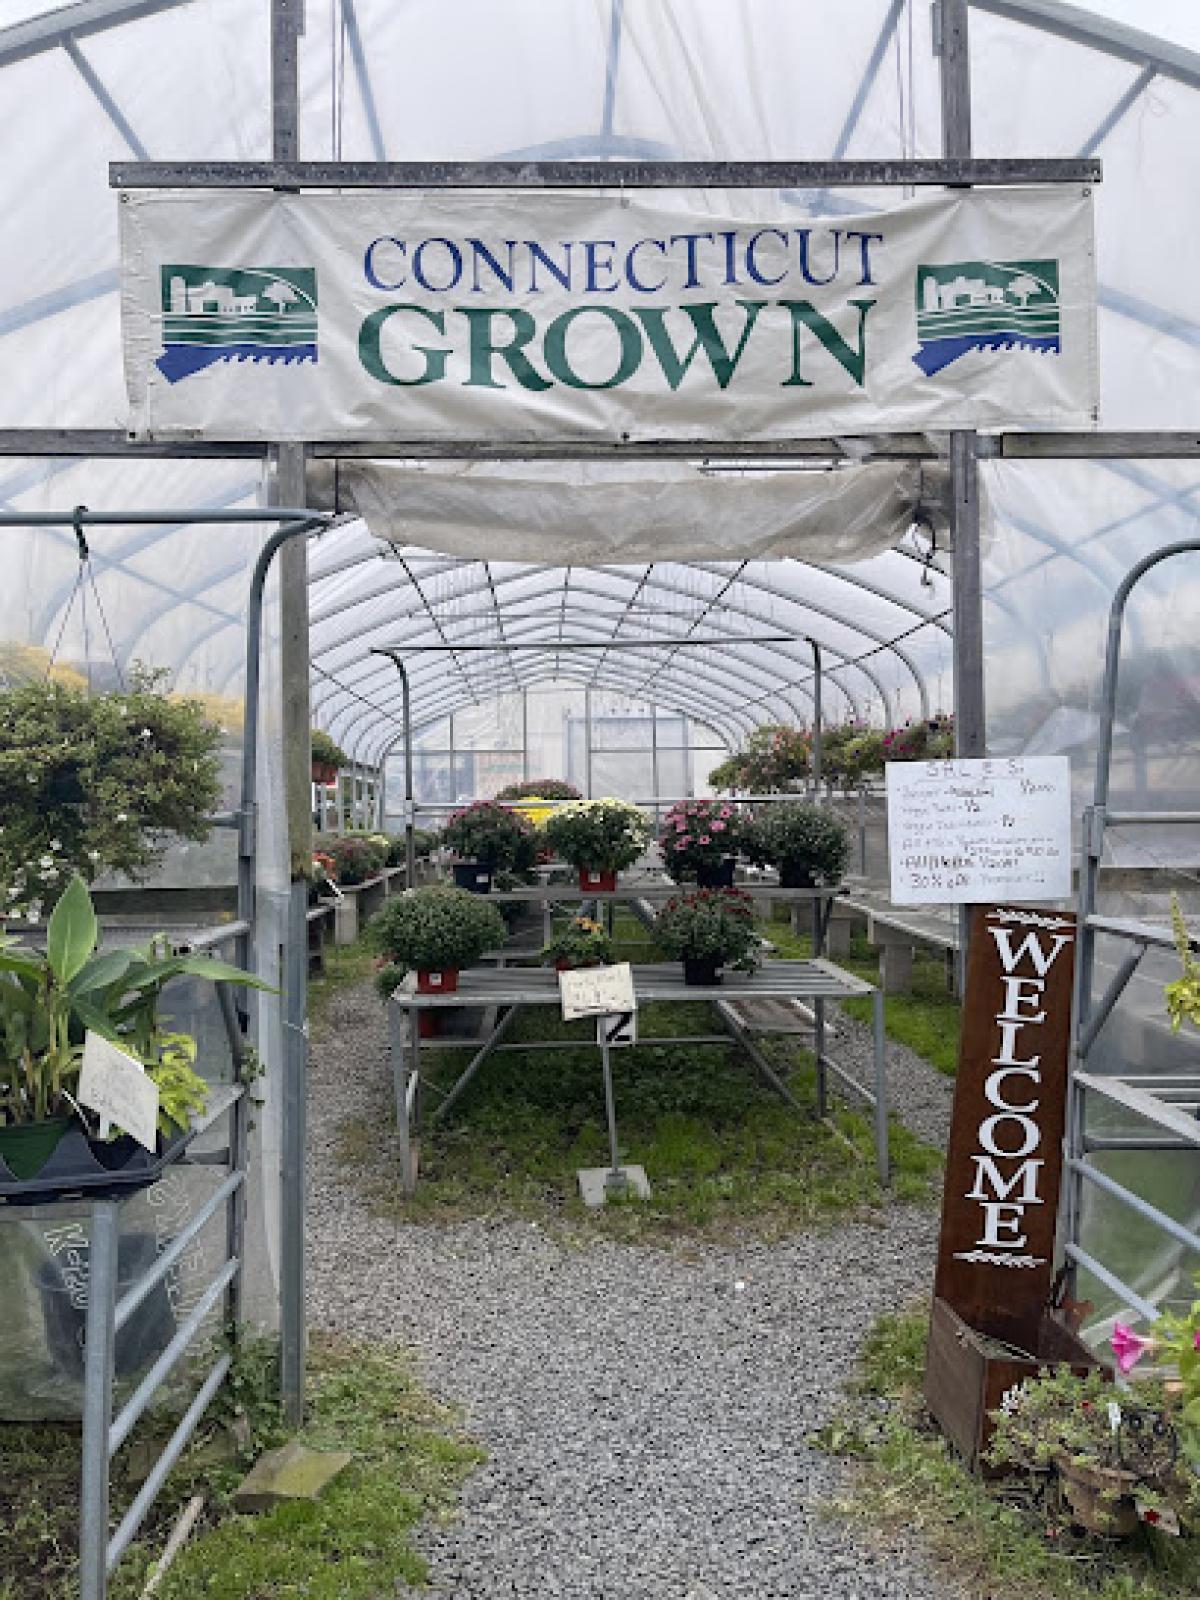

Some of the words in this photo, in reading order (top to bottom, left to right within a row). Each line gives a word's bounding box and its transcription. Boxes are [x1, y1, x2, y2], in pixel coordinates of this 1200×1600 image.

[363, 228, 884, 294] CONNECTICUT
[358, 299, 878, 391] GROWN
[964, 926, 1075, 1248] WELCOME
